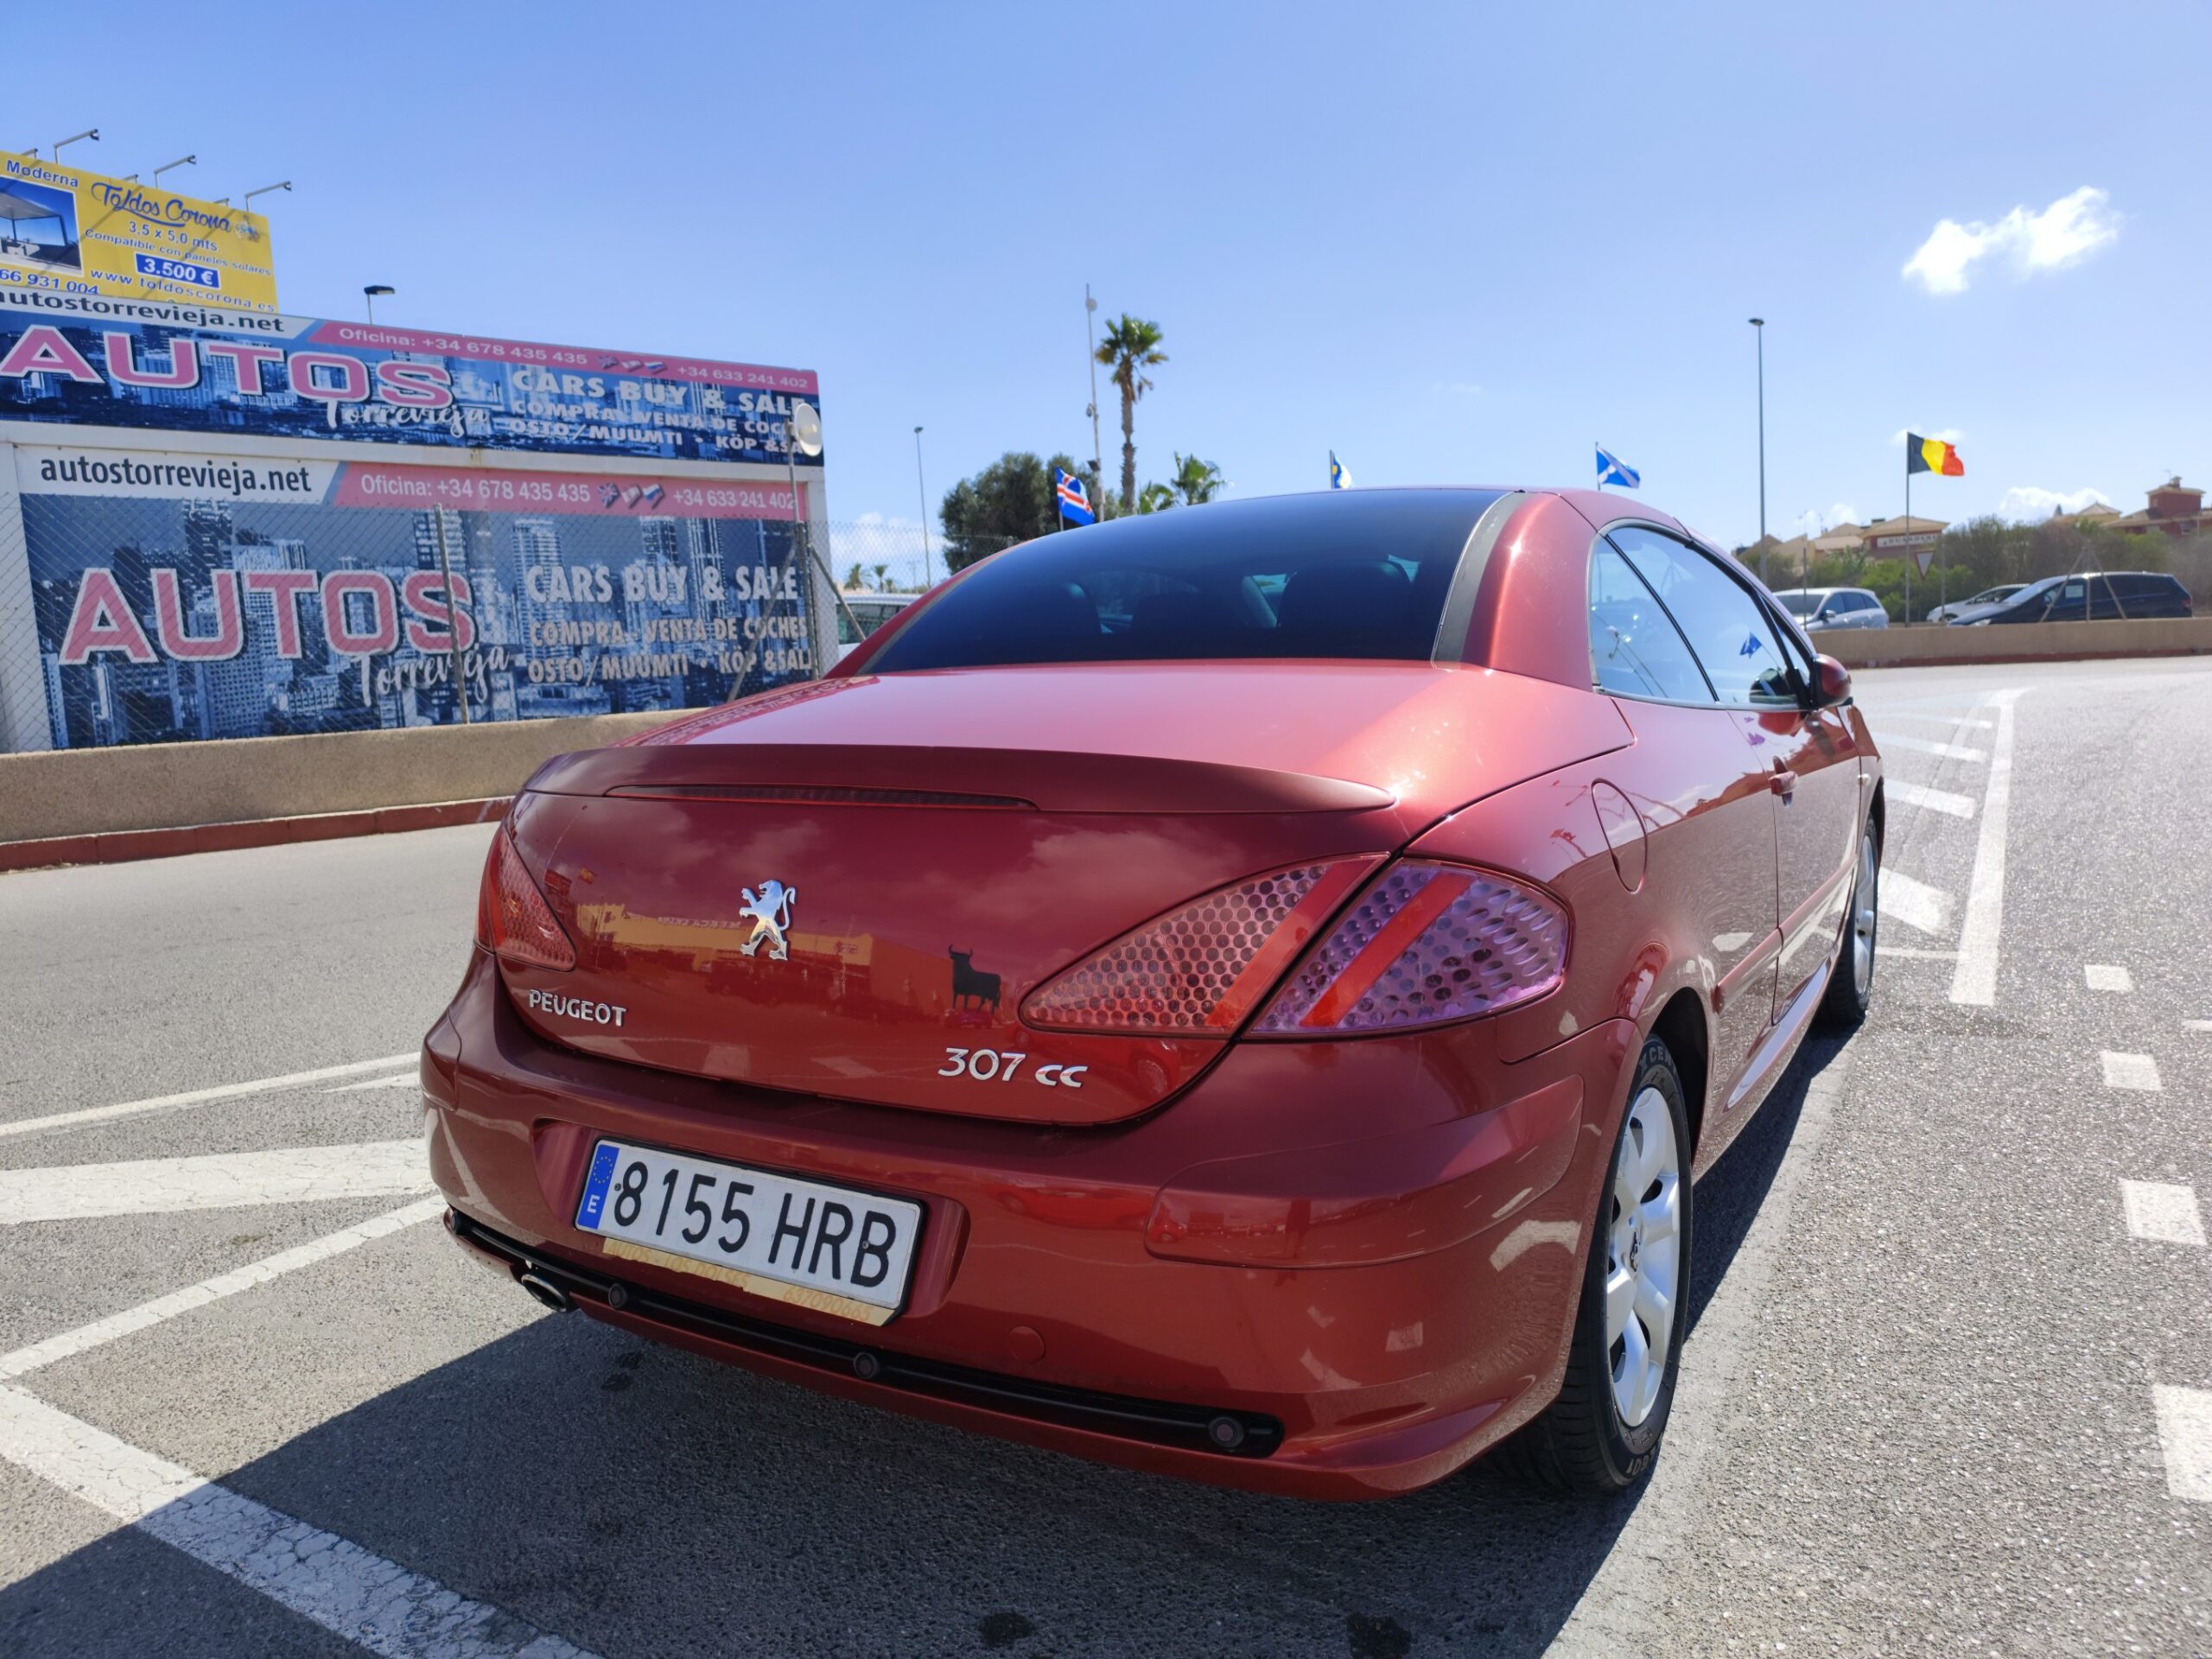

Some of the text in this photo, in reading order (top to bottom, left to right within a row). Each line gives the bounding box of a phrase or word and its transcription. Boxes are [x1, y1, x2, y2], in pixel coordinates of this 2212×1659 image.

[6, 160, 79, 188] Moderna
[91, 181, 232, 232] Toldos Corona
[128, 220, 149, 237] 3,5
[155, 228, 162, 239] x
[168, 229, 188, 245] 5,0
[85, 228, 270, 276] Compatible con paneles solares
[27, 273, 60, 289] 931
[67, 281, 99, 296] 004
[144, 257, 214, 286] 3.500 €
[0, 323, 454, 409] AUTOS
[339, 327, 808, 389] Oficina: +34 678 435 435 +34 633 241 402
[512, 370, 605, 397] CARS
[620, 379, 690, 406] BUY
[703, 389, 726, 410] &
[325, 397, 491, 438] Torrevieja
[512, 400, 616, 420] COMPRA
[638, 410, 709, 430] VENTA
[711, 417, 737, 432] DE
[715, 433, 757, 450] KÖP
[41, 455, 312, 495] autostorrevieja.net
[361, 474, 796, 510] Oficina: +34 678 435 435 +34 633 241 402
[525, 565, 798, 603] CARS BUY & SALE
[59, 567, 476, 665] AUTOS
[530, 620, 626, 646] COMPRA
[645, 618, 707, 643] VENTA
[713, 617, 738, 640] DE
[744, 616, 808, 639] COCHES
[351, 643, 510, 708] Torreveja
[719, 645, 757, 673] KÖP
[529, 988, 626, 1027] PEUGEOT
[938, 1047, 1026, 1082] 307
[586, 1193, 601, 1215] E
[613, 1160, 897, 1287] 8155 HRB
[608, 1241, 651, 1262] AUTOS
